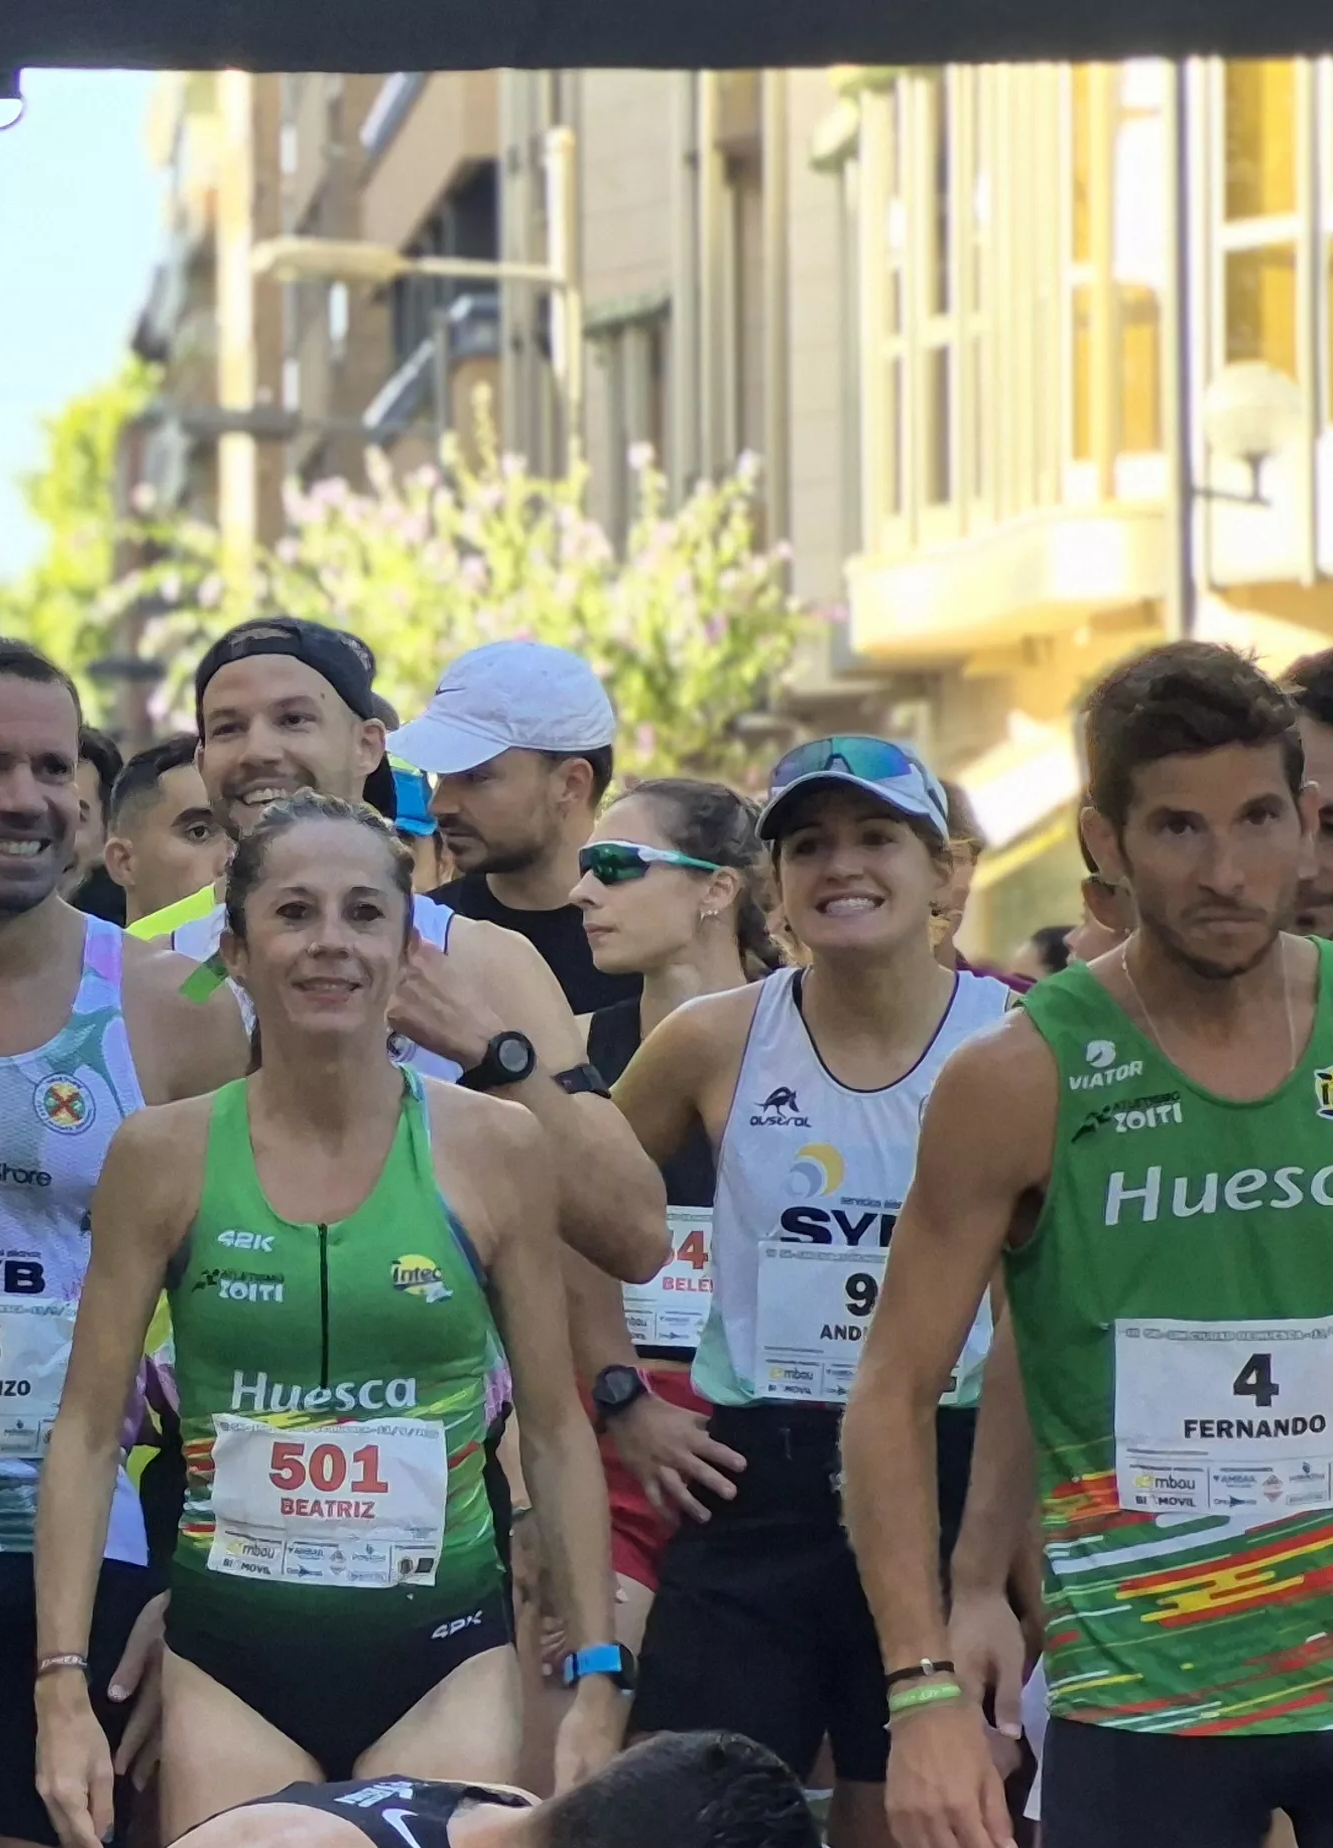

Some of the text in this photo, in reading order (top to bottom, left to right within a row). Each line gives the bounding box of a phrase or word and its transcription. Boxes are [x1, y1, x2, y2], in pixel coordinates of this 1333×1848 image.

[1069, 1061, 1144, 1090] VIATOR
[1113, 1102, 1183, 1134] ZOITI
[1105, 1166, 1333, 1226] Huesc
[217, 1229, 275, 1252] 42K
[845, 1272, 879, 1317] 9
[820, 1324, 863, 1341] AND
[230, 1368, 417, 1413] Huesca
[1233, 1352, 1280, 1408] 4
[1183, 1414, 1327, 1439] FERNANDO
[268, 1441, 389, 1494] 501
[280, 1497, 376, 1519] BEATRIZ
